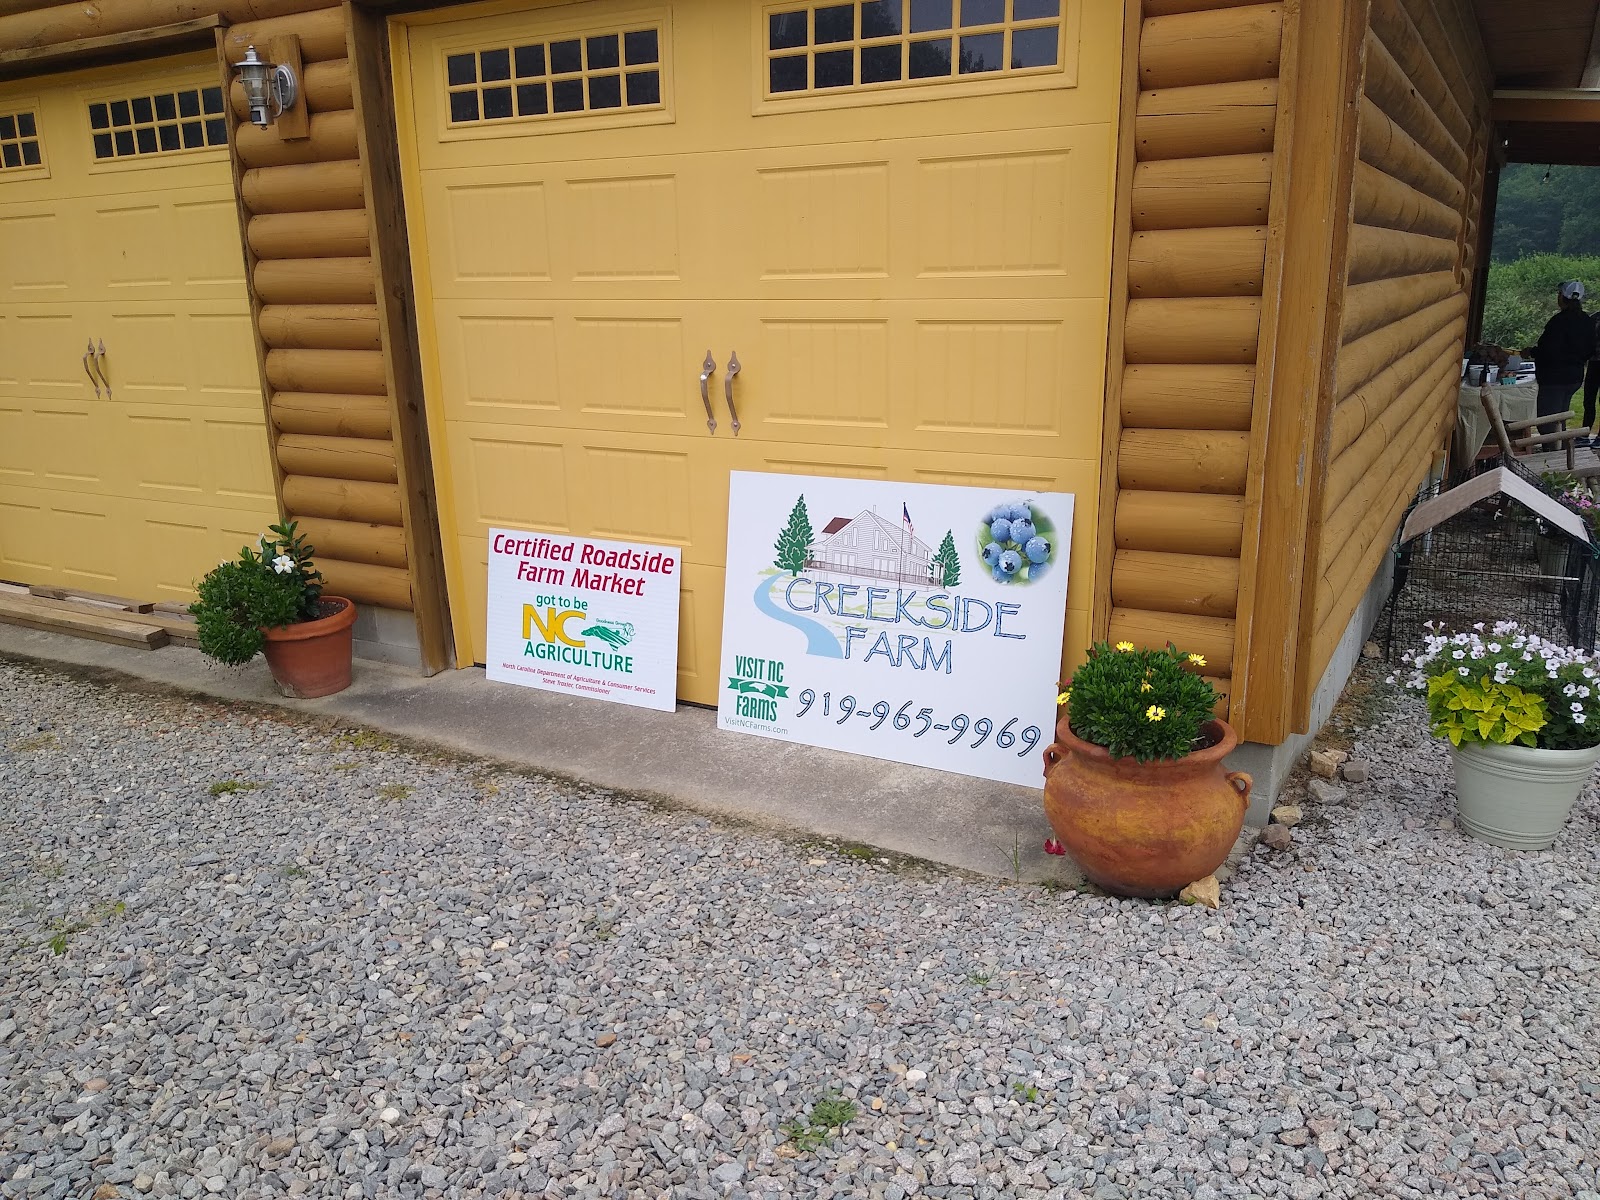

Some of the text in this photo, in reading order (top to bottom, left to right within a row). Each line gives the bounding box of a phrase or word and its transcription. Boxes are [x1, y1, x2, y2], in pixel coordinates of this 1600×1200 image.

[493, 534, 675, 575] Certified Roadside
[517, 561, 646, 597] Farm Market
[536, 594, 588, 610] got to be
[785, 577, 1026, 640] CREEKSIDE
[522, 603, 587, 648] NC
[523, 641, 634, 674] AGRICULTURE
[735, 655, 765, 680] VISIT
[844, 626, 953, 675] FARM
[501, 662, 516, 670] North
[516, 665, 536, 674] Carolina
[537, 668, 566, 679] Department
[573, 674, 601, 685] Agriculture
[607, 681, 633, 690] Consumer
[634, 686, 656, 695] Services
[575, 684, 611, 695] Commissioner
[725, 716, 789, 735] VisitNCFarms.com
[796, 688, 1042, 758] 919-965-9969
